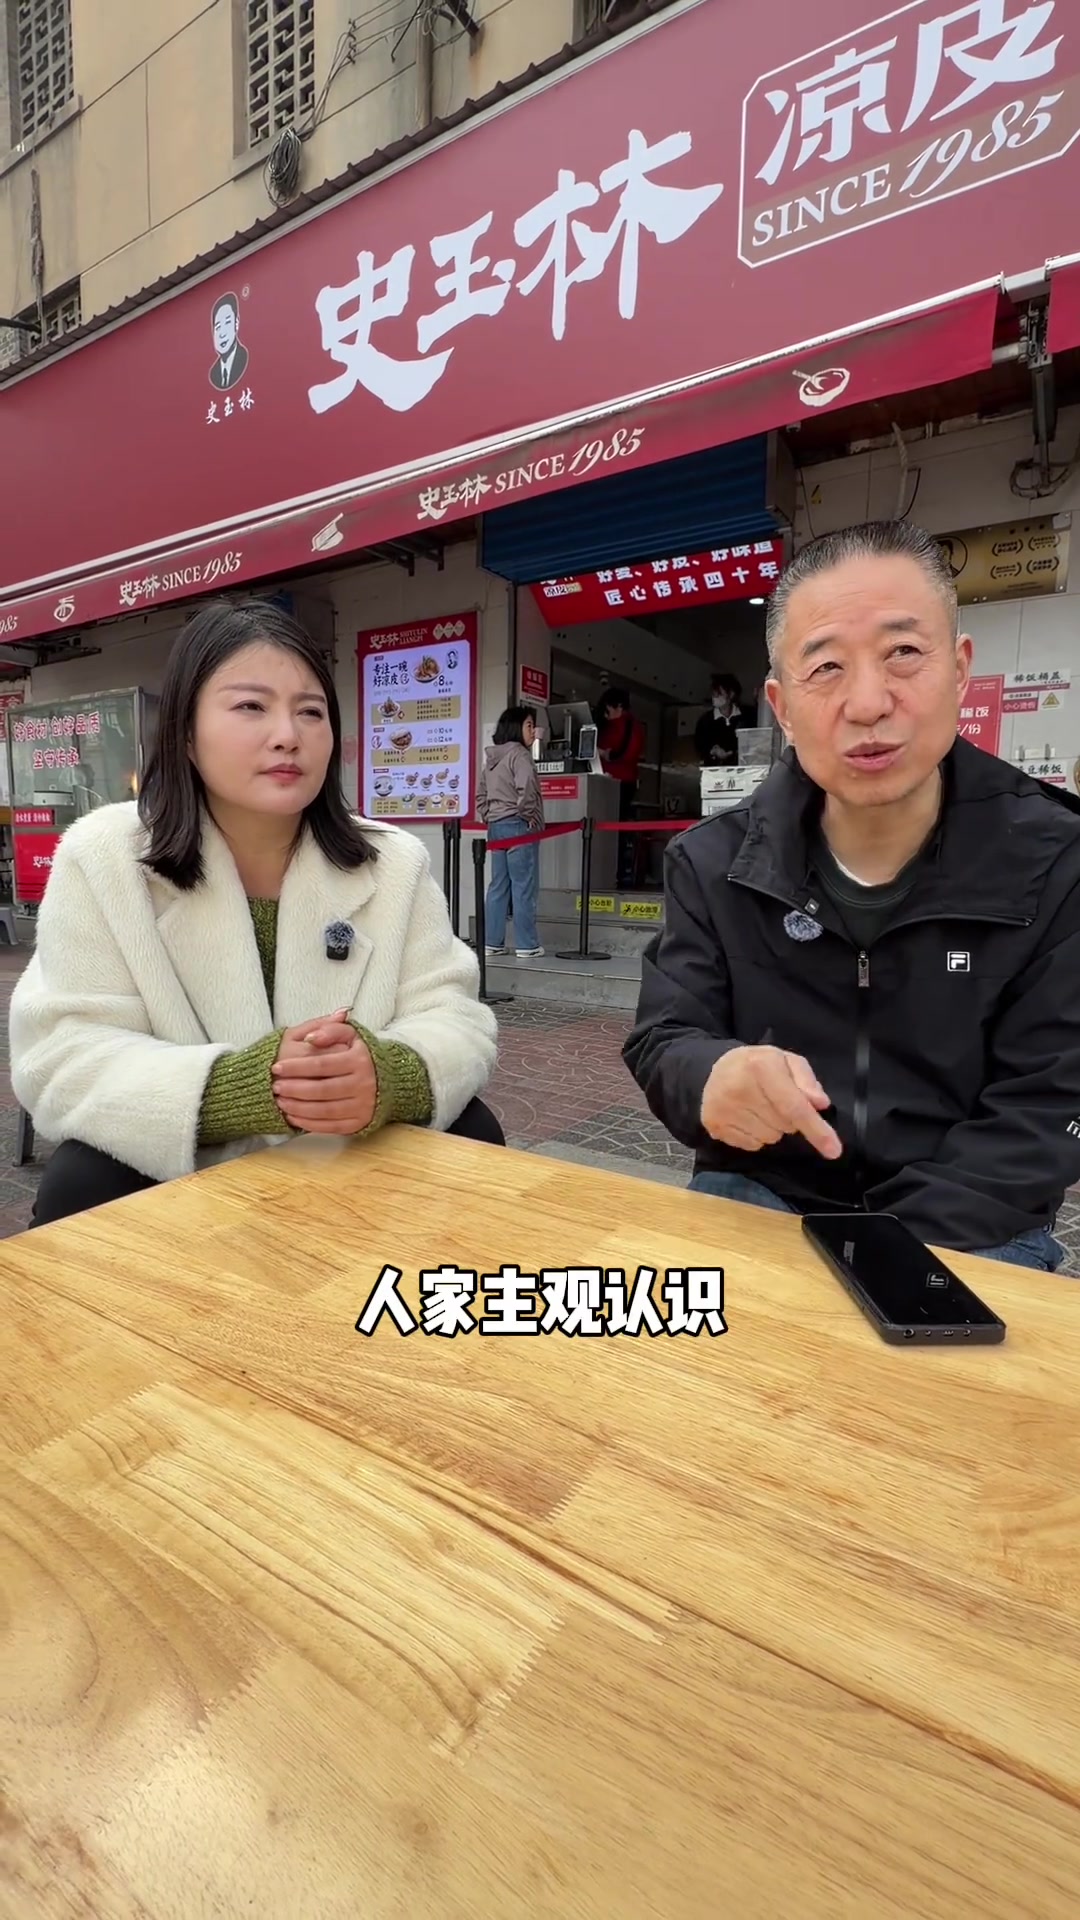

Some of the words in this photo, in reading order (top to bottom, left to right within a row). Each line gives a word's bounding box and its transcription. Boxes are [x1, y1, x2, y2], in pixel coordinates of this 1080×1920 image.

[755, 0, 1064, 185] 凉皮
[752, 163, 891, 248] SINCE
[899, 90, 1064, 198] 1985
[308, 129, 723, 414] 史玉林
[205, 387, 255, 425] 史玉林
[417, 473, 492, 519] 史玉林
[494, 453, 565, 493] SINCE
[567, 427, 645, 477] 1985
[119, 574, 161, 606] 史玉林
[162, 565, 201, 591] SINCE
[202, 551, 243, 584] 1985
[604, 561, 780, 607] 匠心传承四十年
[369, 631, 399, 650] 史玉林
[372, 660, 408, 676] 专注一碗
[1019, 764, 1062, 775] 豆稀饭
